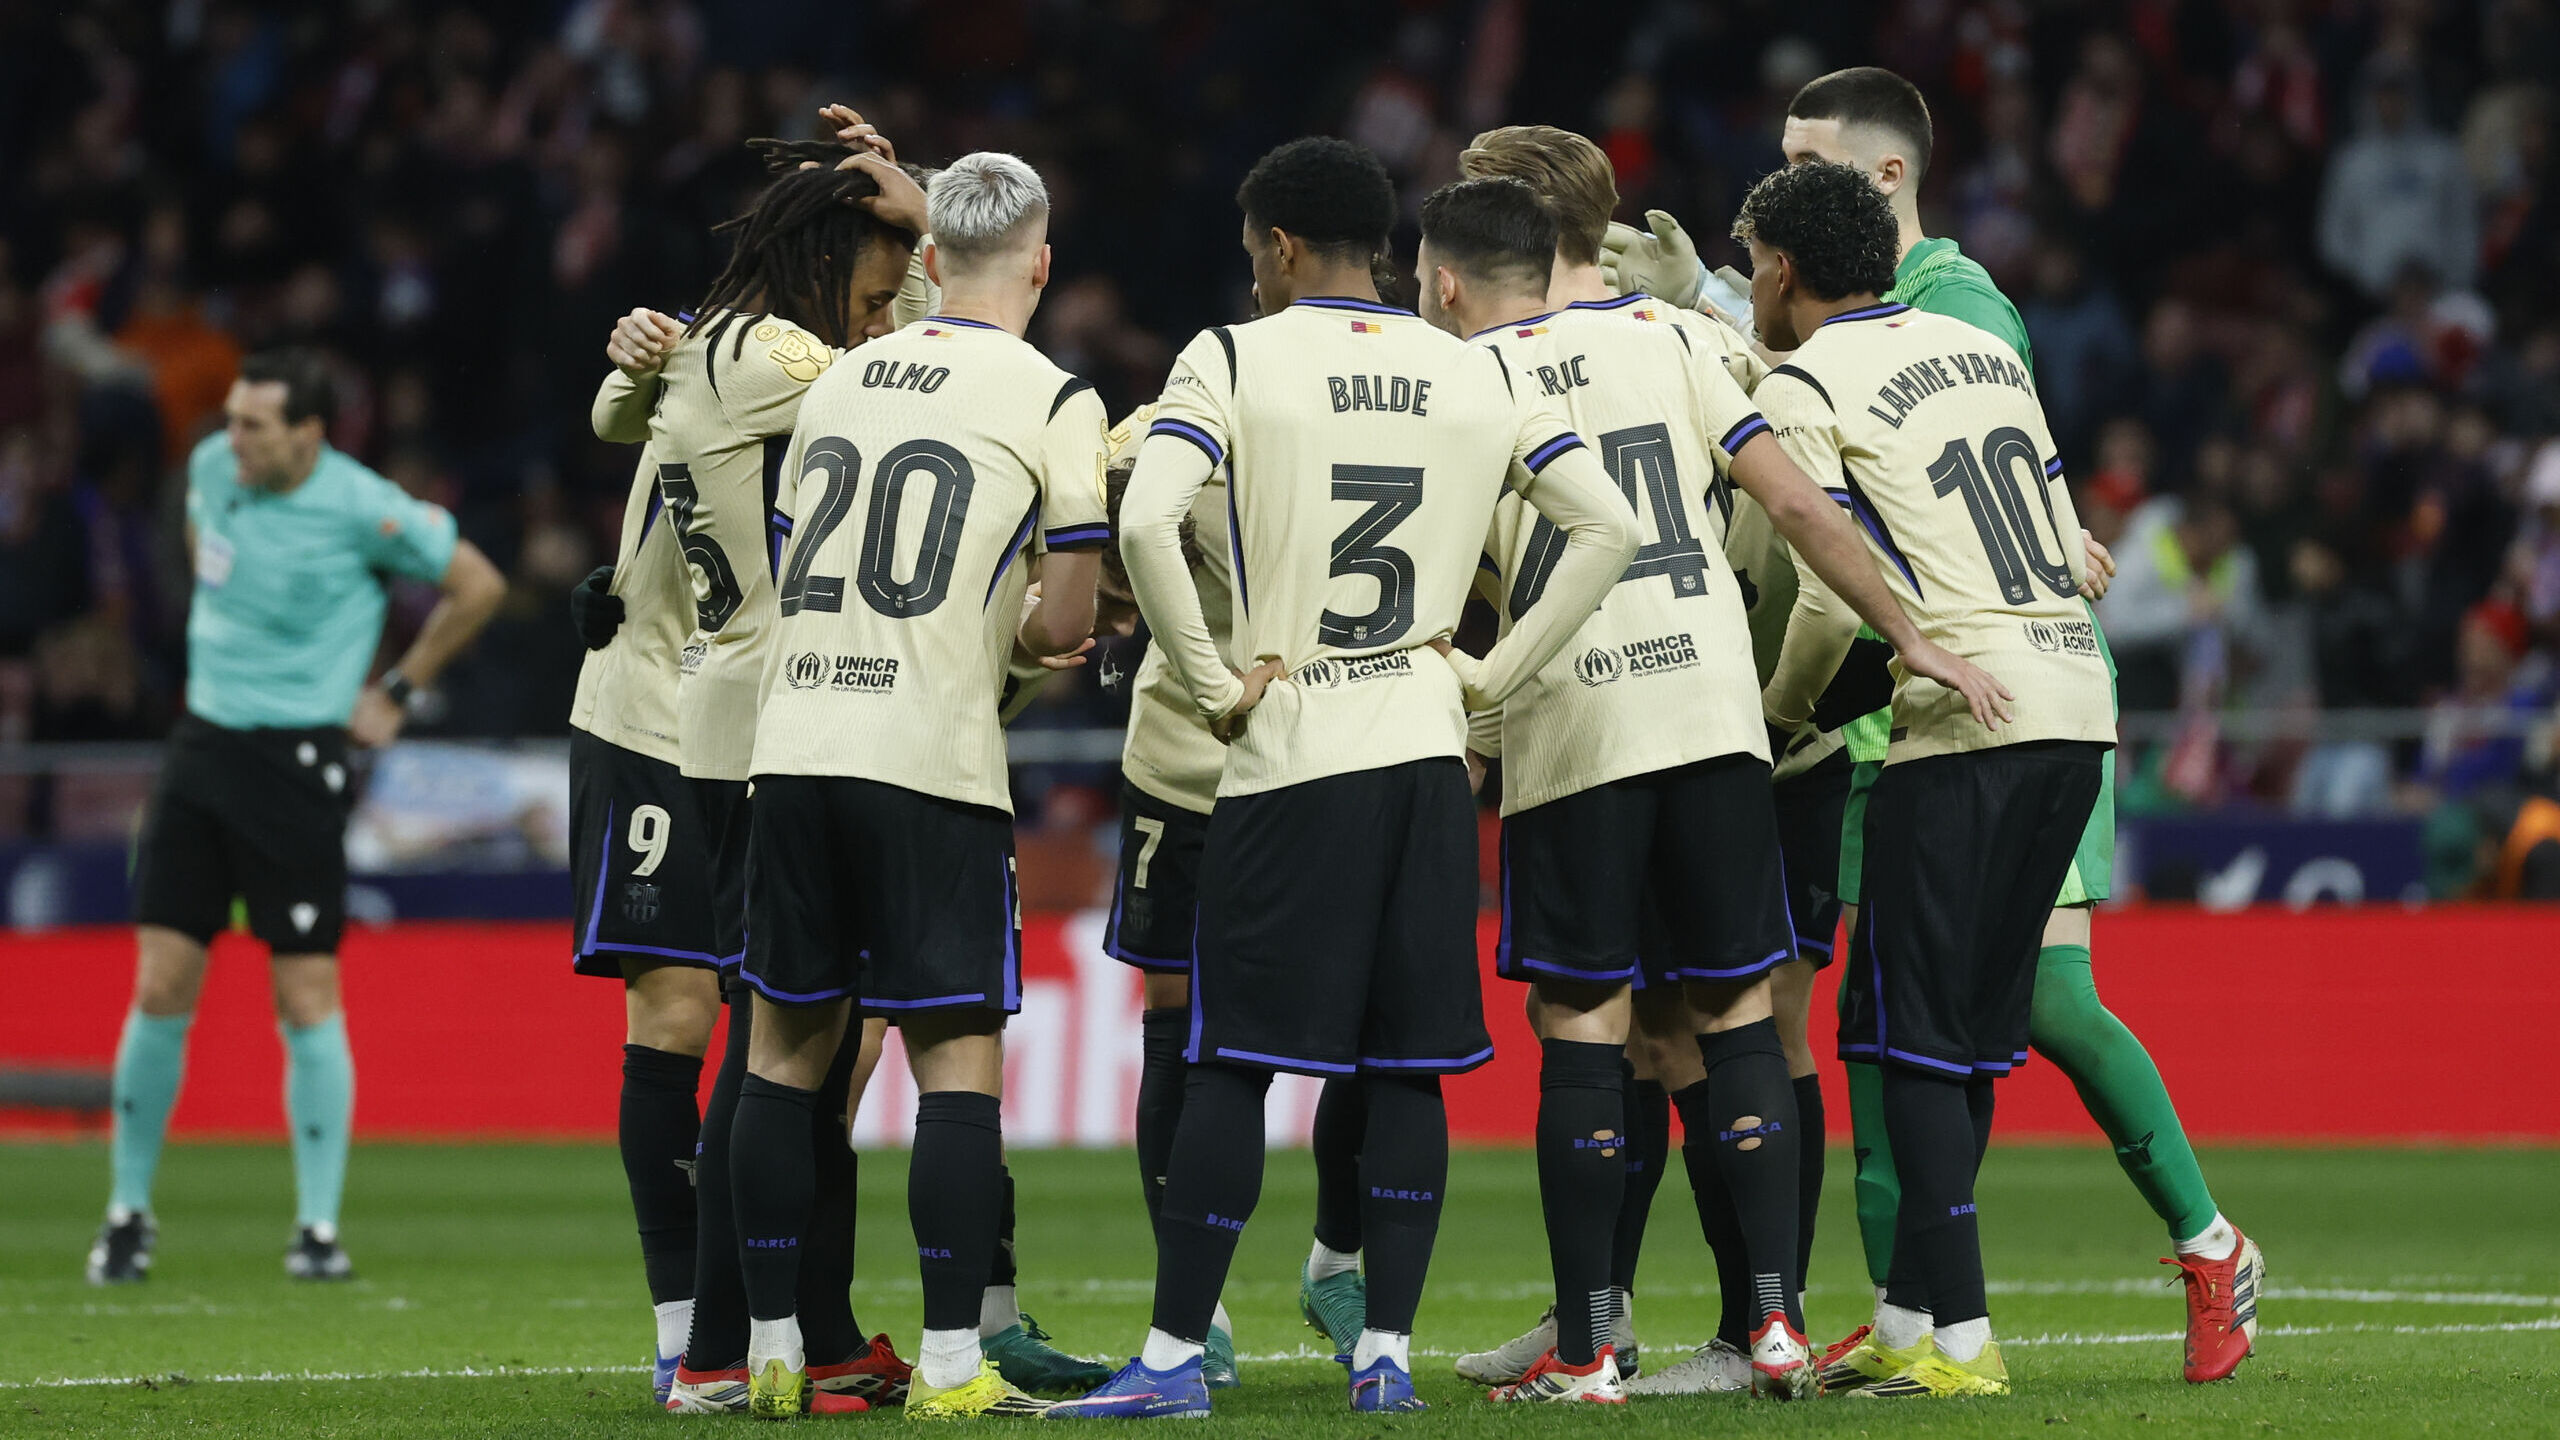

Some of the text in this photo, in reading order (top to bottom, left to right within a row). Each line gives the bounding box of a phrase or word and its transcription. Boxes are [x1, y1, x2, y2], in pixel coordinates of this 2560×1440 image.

[862, 360, 950, 394] OLMO
[1526, 354, 1590, 397] RIC
[1327, 375, 1432, 417] BALDE
[1867, 357, 1957, 430] LAMINE
[780, 436, 976, 618] 20
[1926, 426, 2081, 606] 10
[1318, 463, 1425, 650] 3
[1622, 633, 1695, 658] UNHCR
[2054, 622, 2095, 638] UNHCR
[2063, 635, 2098, 652] ACNUR
[835, 655, 899, 673] UNHCR
[1348, 655, 1412, 680] ACNUR
[1629, 648, 1699, 673] ACNUR
[831, 671, 896, 688] ACNUR
[850, 686, 872, 694] Refugee
[627, 804, 672, 876] 9
[1134, 815, 1165, 889] 7
